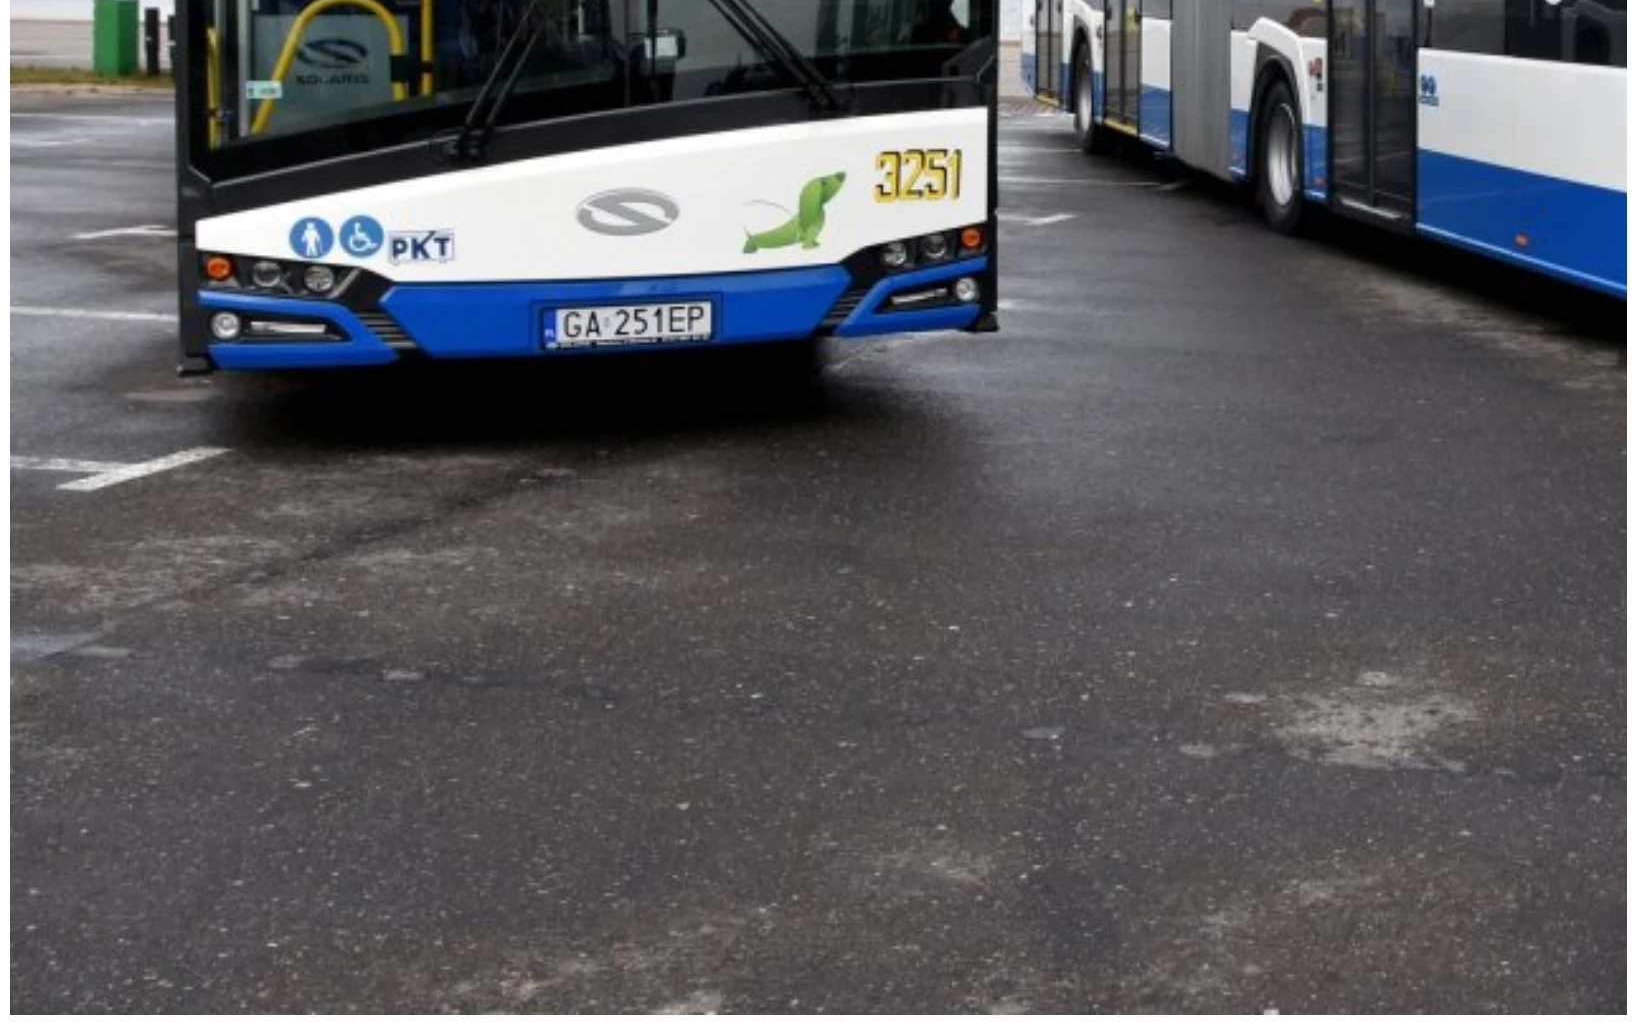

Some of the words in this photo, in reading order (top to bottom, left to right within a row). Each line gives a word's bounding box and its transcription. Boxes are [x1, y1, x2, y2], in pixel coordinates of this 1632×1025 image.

[873, 148, 963, 203] 3251
[391, 231, 450, 260] PKT
[563, 311, 600, 338] GA
[614, 306, 704, 336] 251EP
